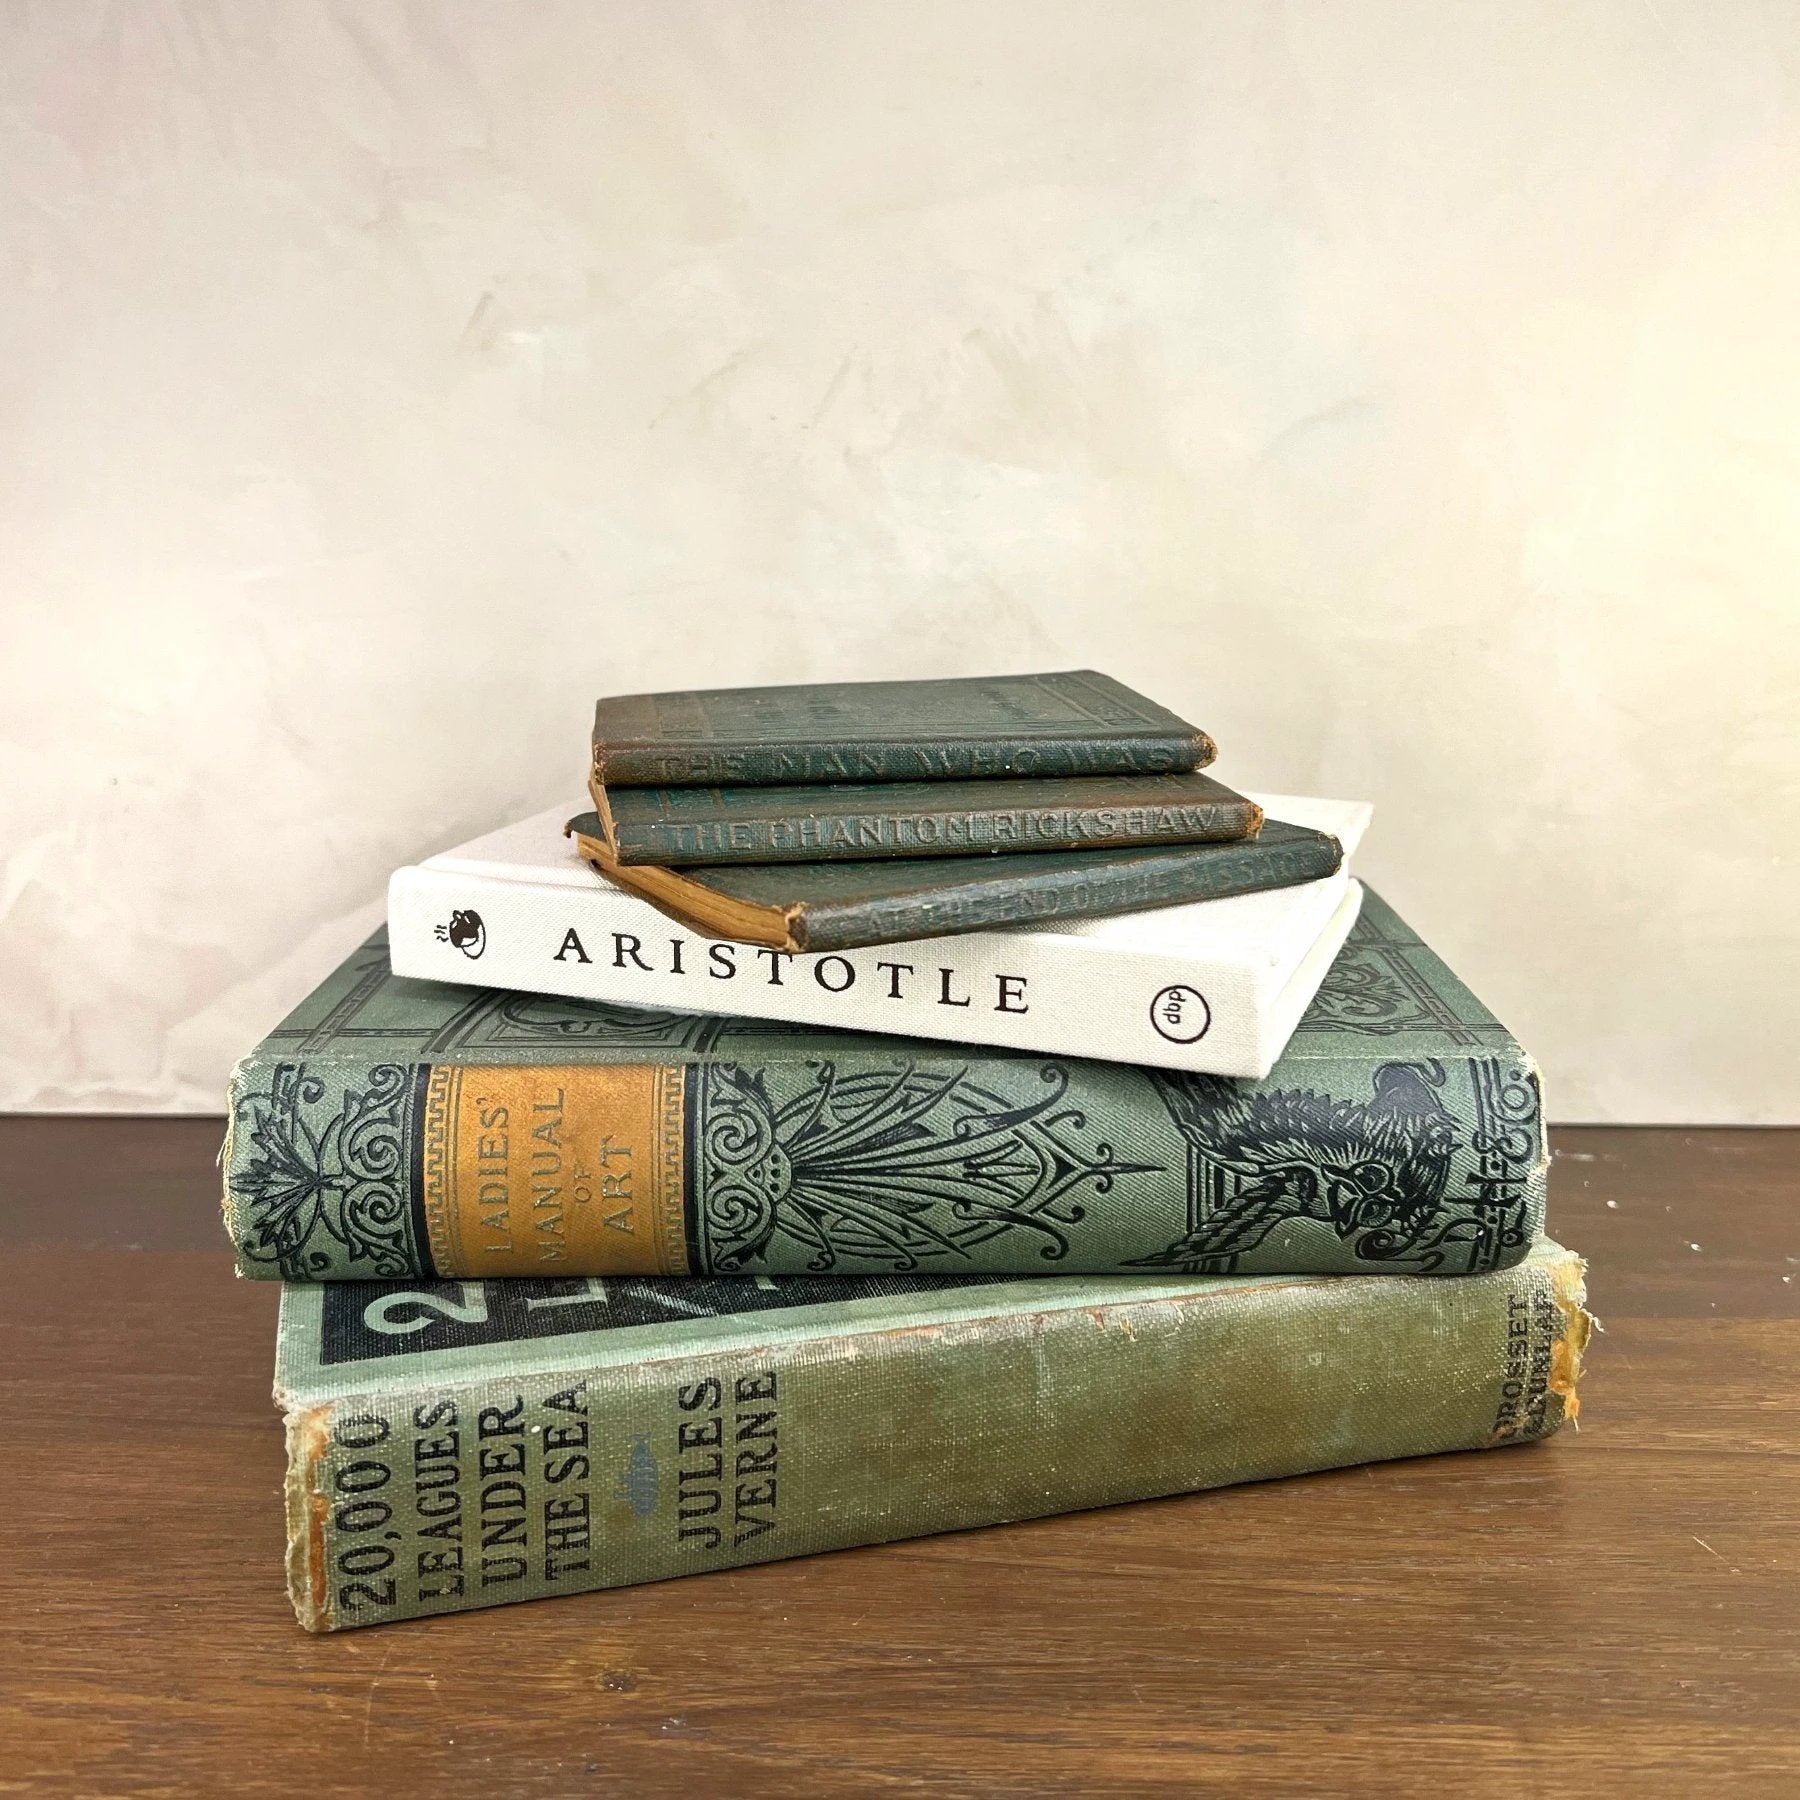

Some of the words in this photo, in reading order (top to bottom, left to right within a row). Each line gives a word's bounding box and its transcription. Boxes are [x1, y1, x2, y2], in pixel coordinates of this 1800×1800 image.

[656, 753, 748, 779] THE
[667, 822, 752, 850] THE
[771, 810, 978, 849] PHANTOM
[991, 802, 1217, 841] RICKSHAW
[552, 926, 1032, 1015] ARISTOTLE
[1162, 990, 1187, 1024] dbp
[475, 1097, 510, 1254] LADIES'
[531, 1088, 565, 1262] MANUAL
[573, 1159, 592, 1203] OF
[599, 1135, 635, 1236] ART
[543, 1379, 592, 1486] SEA
[678, 1376, 723, 1550] JULES
[733, 1371, 778, 1548] VERNE
[333, 1412, 402, 1611] 20,000
[413, 1399, 465, 1602] LEAGUES
[478, 1394, 529, 1588] UNDER
[544, 1492, 592, 1582] THE
